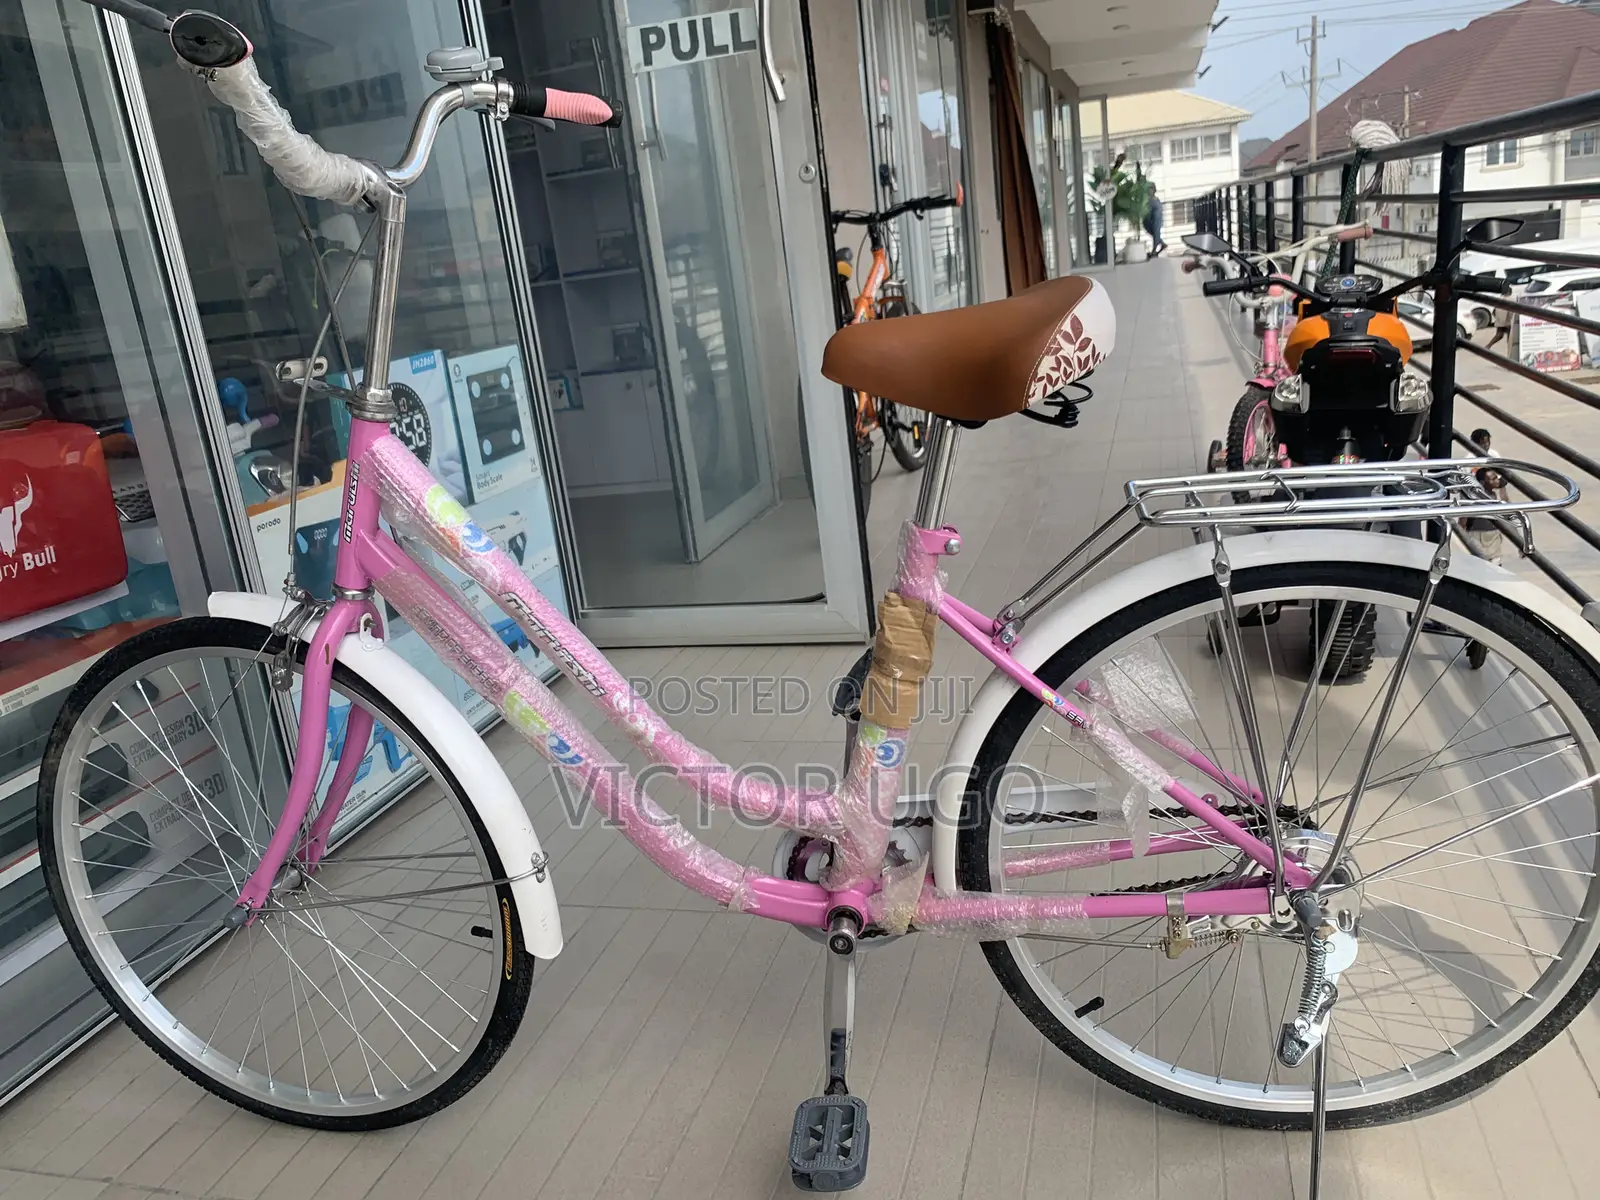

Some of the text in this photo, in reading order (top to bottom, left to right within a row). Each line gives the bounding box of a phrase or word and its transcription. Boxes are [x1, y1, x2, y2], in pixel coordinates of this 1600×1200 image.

[639, 12, 757, 66] PULL
[477, 477, 490, 490] Body
[256, 518, 281, 532] porodo
[22, 545, 57, 571] Bull
